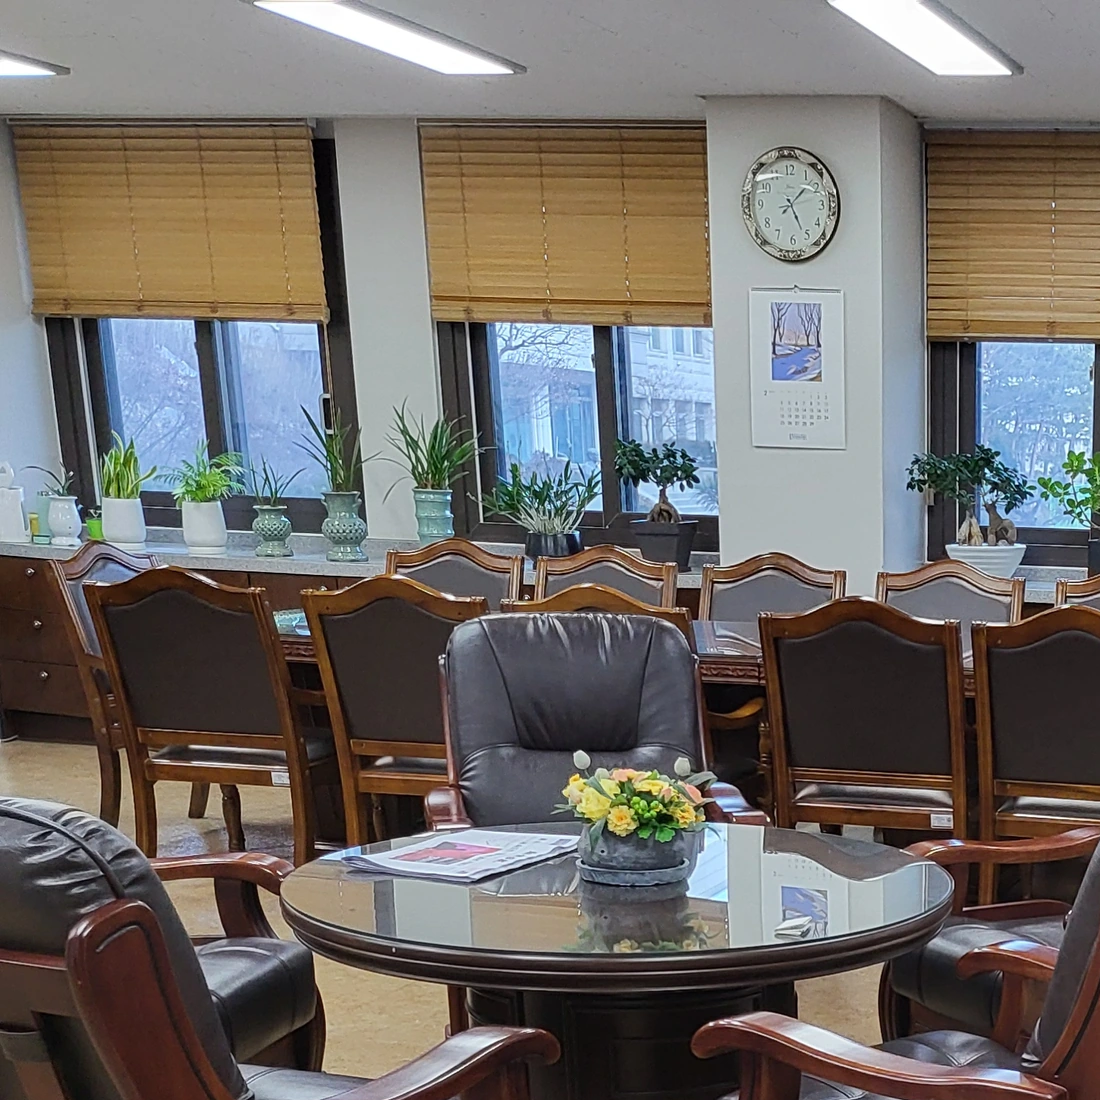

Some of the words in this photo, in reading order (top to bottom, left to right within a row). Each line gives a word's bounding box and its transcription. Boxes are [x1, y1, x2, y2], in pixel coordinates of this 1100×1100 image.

[785, 164, 795, 176] 12
[804, 170, 808, 181] 1
[761, 182, 771, 193] 10
[812, 182, 820, 193] 2
[757, 199, 764, 210] 9
[818, 199, 825, 210] 3
[764, 217, 771, 228] 8
[814, 217, 820, 228] 4
[775, 229, 781, 240] 7
[790, 234, 797, 245] 6
[804, 229, 810, 240] 5
